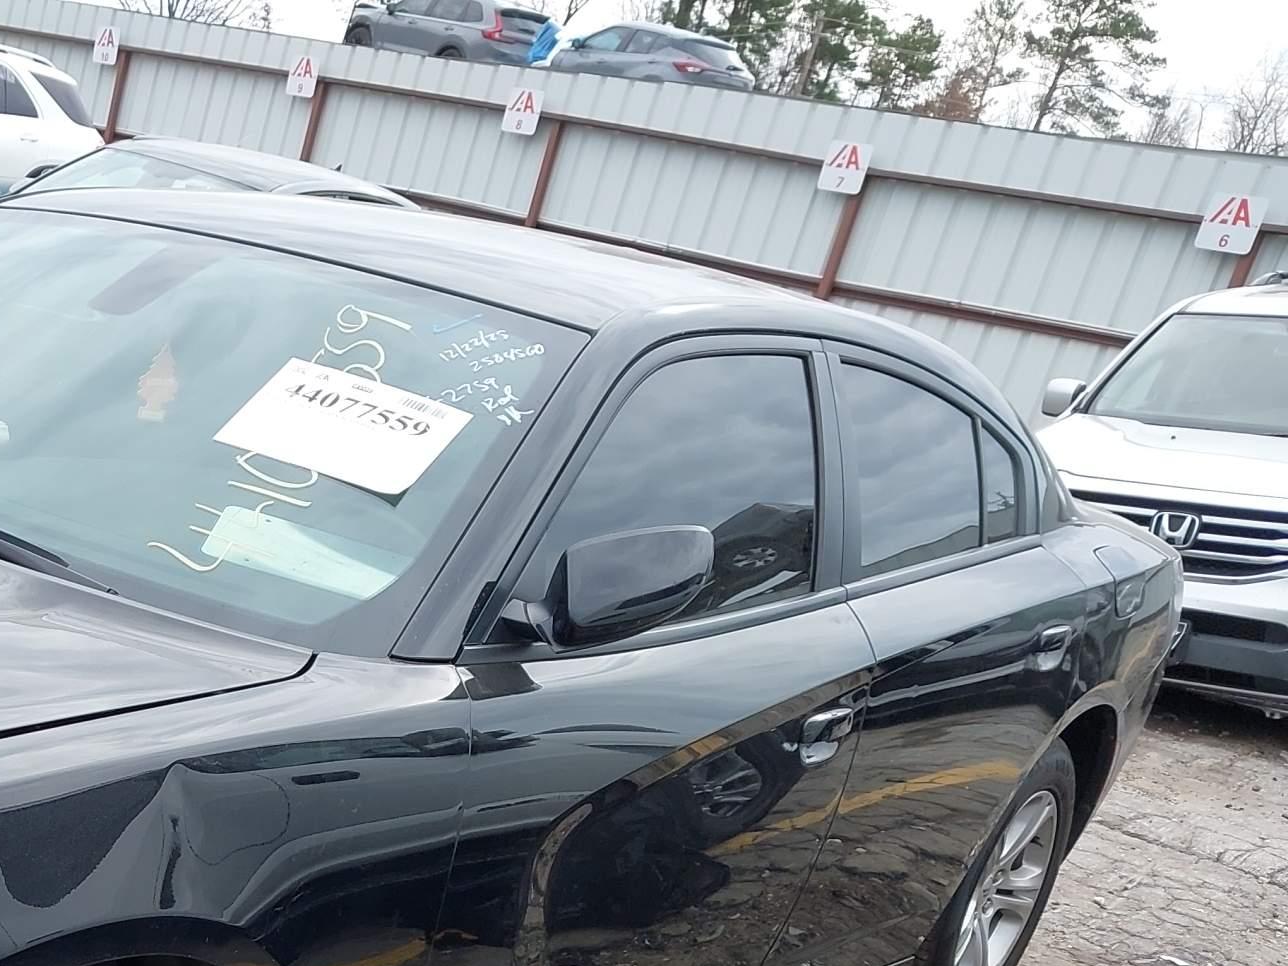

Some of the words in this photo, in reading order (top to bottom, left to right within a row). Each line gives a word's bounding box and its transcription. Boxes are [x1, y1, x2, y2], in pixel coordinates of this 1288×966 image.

[297, 83, 304, 93] 9
[835, 175, 846, 188] 7
[1218, 233, 1231, 248] 6
[438, 329, 510, 362] 12/22/25
[285, 383, 431, 436] 44077559
